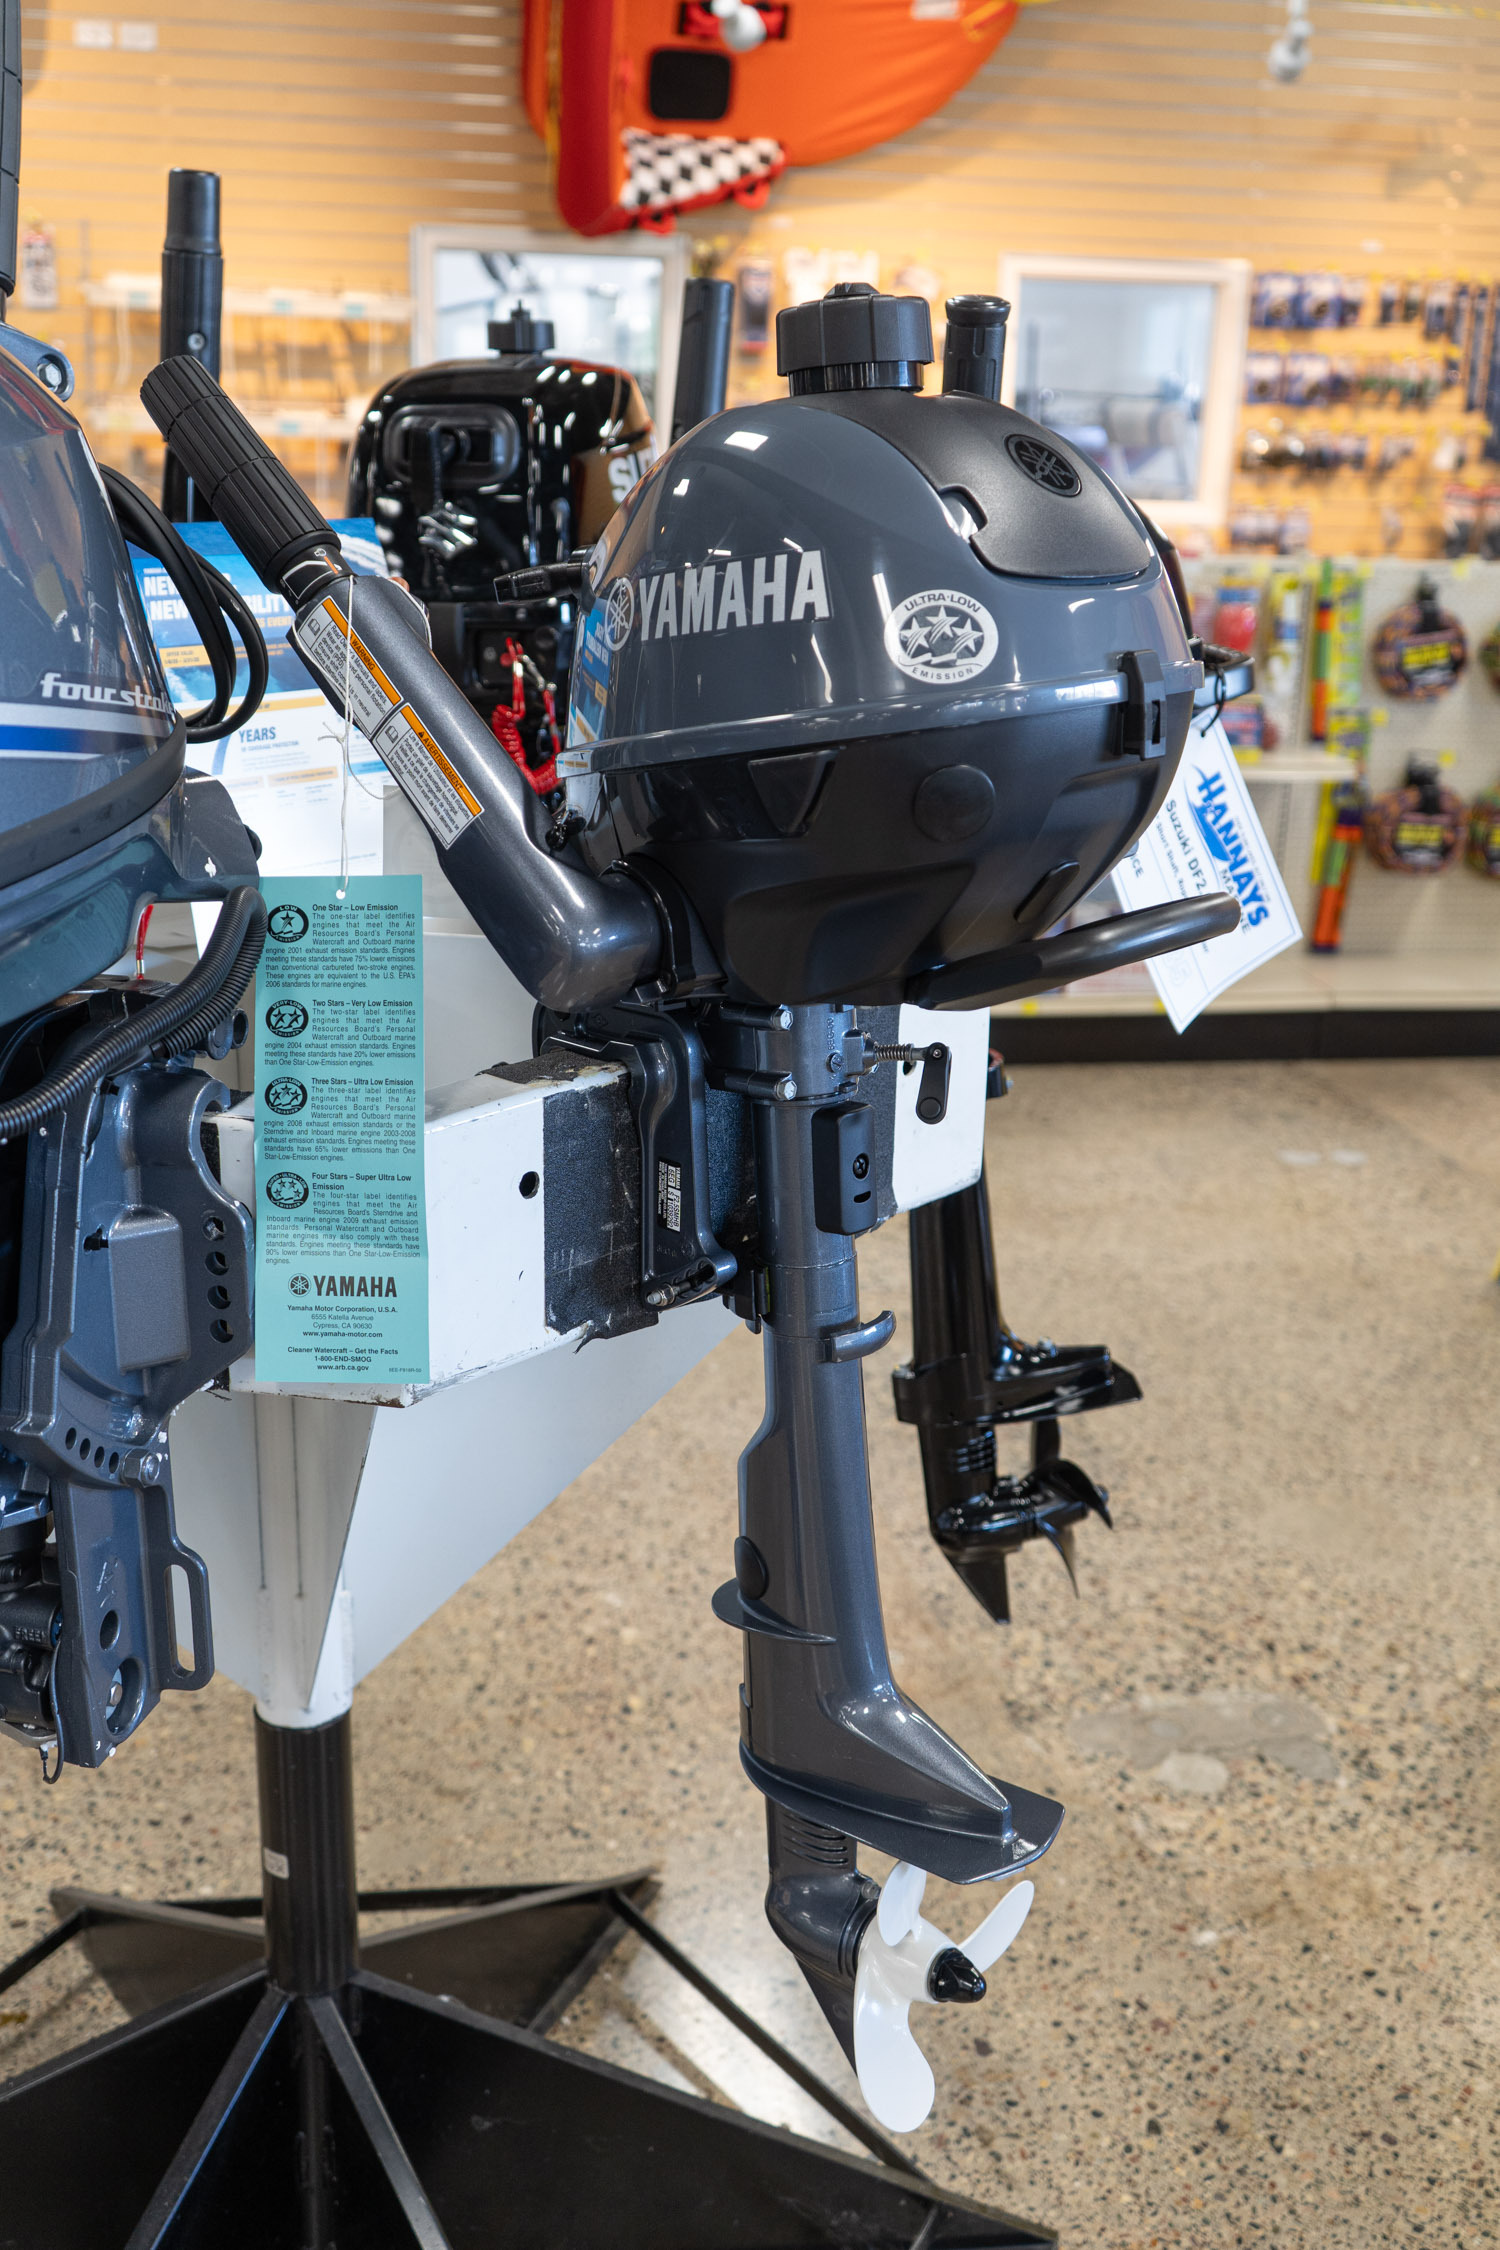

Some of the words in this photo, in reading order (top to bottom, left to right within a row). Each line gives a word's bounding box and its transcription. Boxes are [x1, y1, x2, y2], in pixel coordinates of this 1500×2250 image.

[639, 550, 830, 642] YAMAHA
[321, 636, 335, 654] device
[330, 624, 342, 639] Read
[353, 657, 371, 679] Manuals
[367, 677, 377, 689] and
[350, 638, 375, 670] WARNING
[313, 648, 326, 664] before
[324, 663, 339, 683] starting
[325, 630, 337, 644] Wear
[354, 672, 372, 695] personal
[317, 641, 331, 660] Ensure
[329, 659, 339, 671] shift
[352, 692, 359, 700] in
[911, 666, 974, 681] EMISSION
[238, 726, 277, 744] YEARS
[402, 737, 415, 753] Portez
[414, 756, 425, 768] gilet
[422, 736, 462, 790] AVERTISSEMENT
[417, 744, 431, 761] Manuel
[449, 791, 458, 800] les
[422, 765, 429, 773] de
[405, 768, 416, 780] point
[420, 788, 431, 801] avant
[425, 772, 443, 793] sauvetage
[1166, 799, 1193, 856] Suzuki
[1197, 772, 1269, 927] HANNAYS
[312, 903, 327, 912] One
[328, 903, 343, 912] Star
[350, 903, 365, 911] Low
[366, 903, 398, 911] Emission
[311, 912, 325, 920] The
[329, 912, 359, 920] one-star
[363, 912, 381, 920] label
[384, 911, 415, 920] identifies
[312, 922, 339, 930] engines
[345, 920, 360, 928] that
[388, 920, 400, 928] the
[405, 920, 415, 928] Air
[312, 929, 349, 937] Resources
[354, 929, 380, 937] Board's
[385, 928, 415, 937] Personal
[312, 937, 345, 946] Watercraft
[347, 937, 360, 946] and
[362, 937, 391, 946] Outboard
[265, 947, 285, 956] engine
[287, 946, 302, 954] 2001
[305, 946, 328, 954] exhaust
[359, 946, 390, 954] standards.
[392, 946, 415, 955] Engines
[265, 954, 289, 964] meeting
[290, 955, 307, 963] these
[308, 955, 337, 963] standards
[338, 954, 353, 963] have
[354, 954, 368, 963] 75%
[369, 954, 385, 962] lower
[386, 954, 415, 962] emissions
[265, 963, 279, 971] than
[281, 963, 319, 971] conventional
[321, 963, 354, 971] carbureted
[357, 963, 388, 971] two-stroke
[390, 964, 415, 972] engines.
[265, 971, 285, 979] These
[287, 973, 311, 981] engines
[327, 972, 358, 981] equivalent
[383, 971, 396, 980] U.S.
[398, 971, 416, 979] EPA's
[265, 980, 280, 988] 2006
[281, 980, 310, 988] standards
[311, 980, 320, 988] for
[342, 980, 368, 989] engines.
[312, 999, 326, 1007] Two
[327, 999, 344, 1007] Stars
[351, 999, 366, 1008] Very
[367, 999, 381, 1007] Low
[382, 999, 413, 1007] Emission
[311, 1077, 329, 1085] Three
[330, 1077, 347, 1085] Stars
[353, 1077, 369, 1086] Ultra
[370, 1077, 383, 1086] Low
[384, 1077, 413, 1086] Emission
[311, 1172, 328, 1180] Four
[329, 1172, 348, 1180] Stars
[355, 1172, 376, 1182] Super
[377, 1173, 395, 1181] Ultra
[396, 1173, 411, 1182] Low
[311, 1182, 345, 1191] Emission
[312, 1275, 398, 1298] YAMAHA
[314, 1304, 334, 1312] Motor
[334, 1305, 376, 1313] Corporation,
[328, 1313, 349, 1321] Katella
[312, 1321, 339, 1330] Cypress,
[352, 1322, 372, 1330] 90630
[302, 1330, 383, 1338] www.yamaha-motor.com
[313, 1346, 348, 1354] Watercraft
[367, 1347, 379, 1355] the
[314, 1355, 372, 1363] 1-800-END-SMOG
[316, 1363, 369, 1372] www.arb.ca.gov
